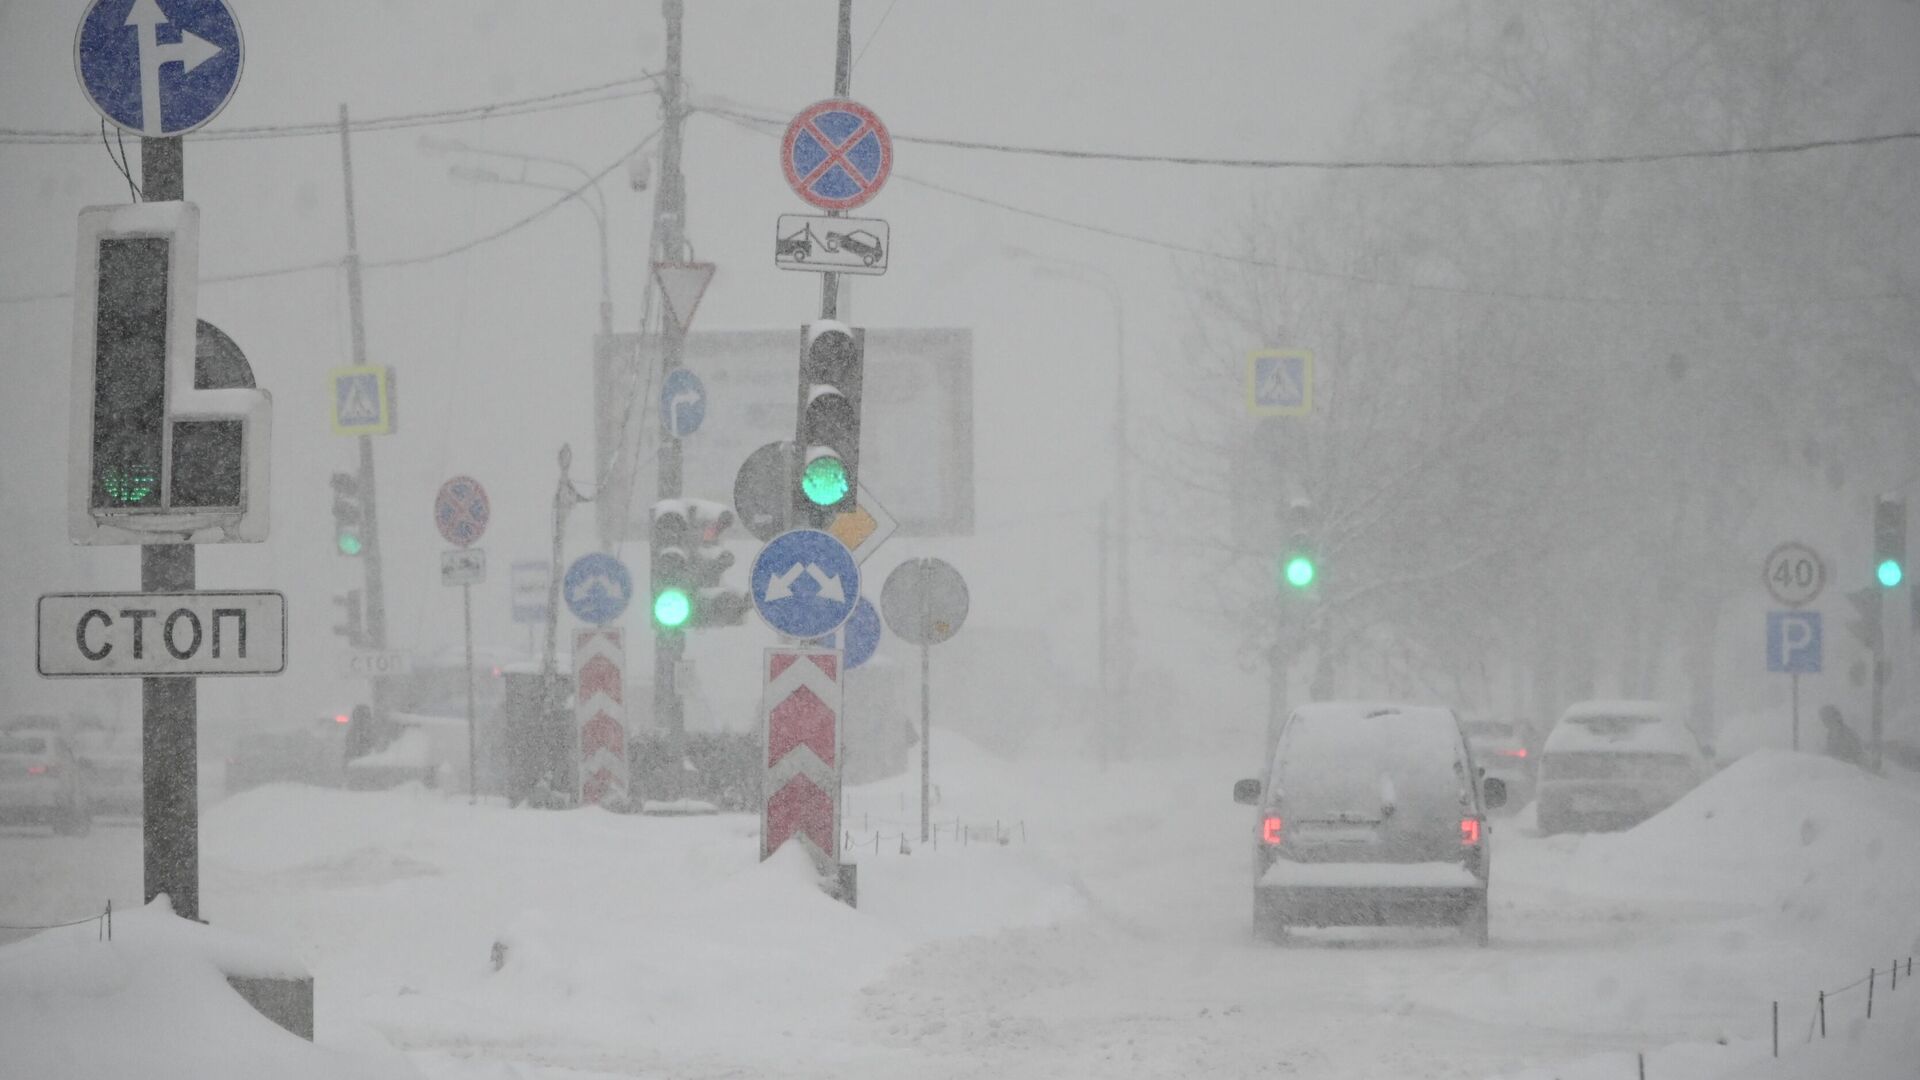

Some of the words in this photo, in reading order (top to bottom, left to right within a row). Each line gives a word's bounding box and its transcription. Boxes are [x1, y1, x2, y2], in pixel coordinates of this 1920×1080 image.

[1772, 558, 1813, 588] 40
[75, 606, 248, 661] СТОП
[1782, 617, 1812, 666] P
